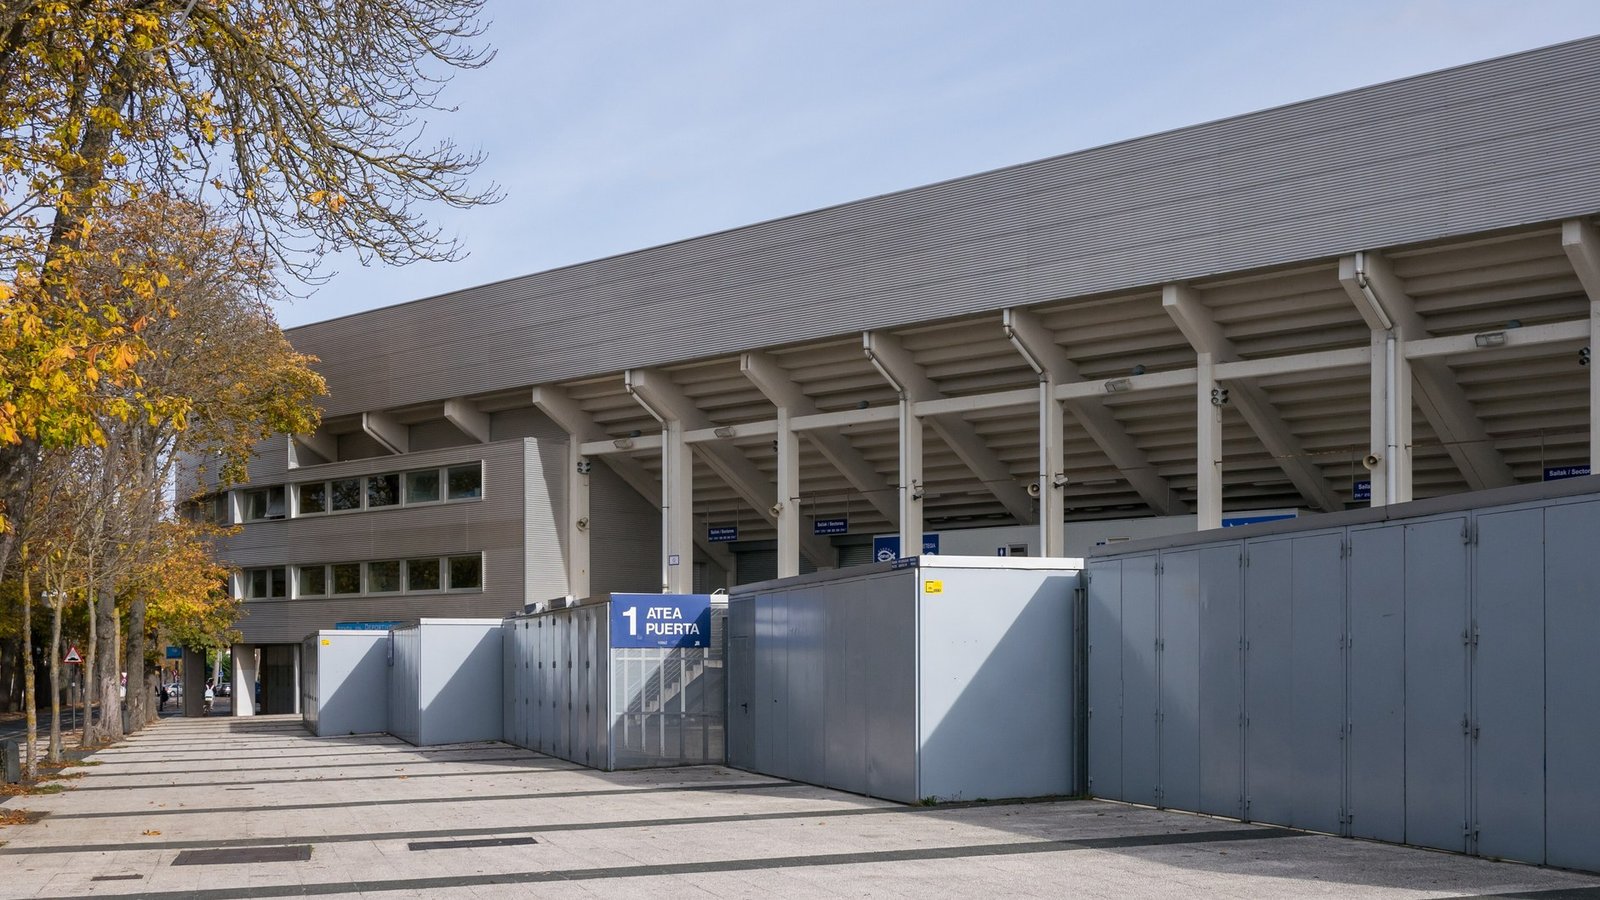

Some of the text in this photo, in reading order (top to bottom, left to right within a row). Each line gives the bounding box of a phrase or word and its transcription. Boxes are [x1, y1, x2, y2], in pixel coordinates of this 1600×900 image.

[646, 607, 682, 619] ATEA
[622, 606, 637, 635] 1
[646, 623, 700, 635] PUERTA
